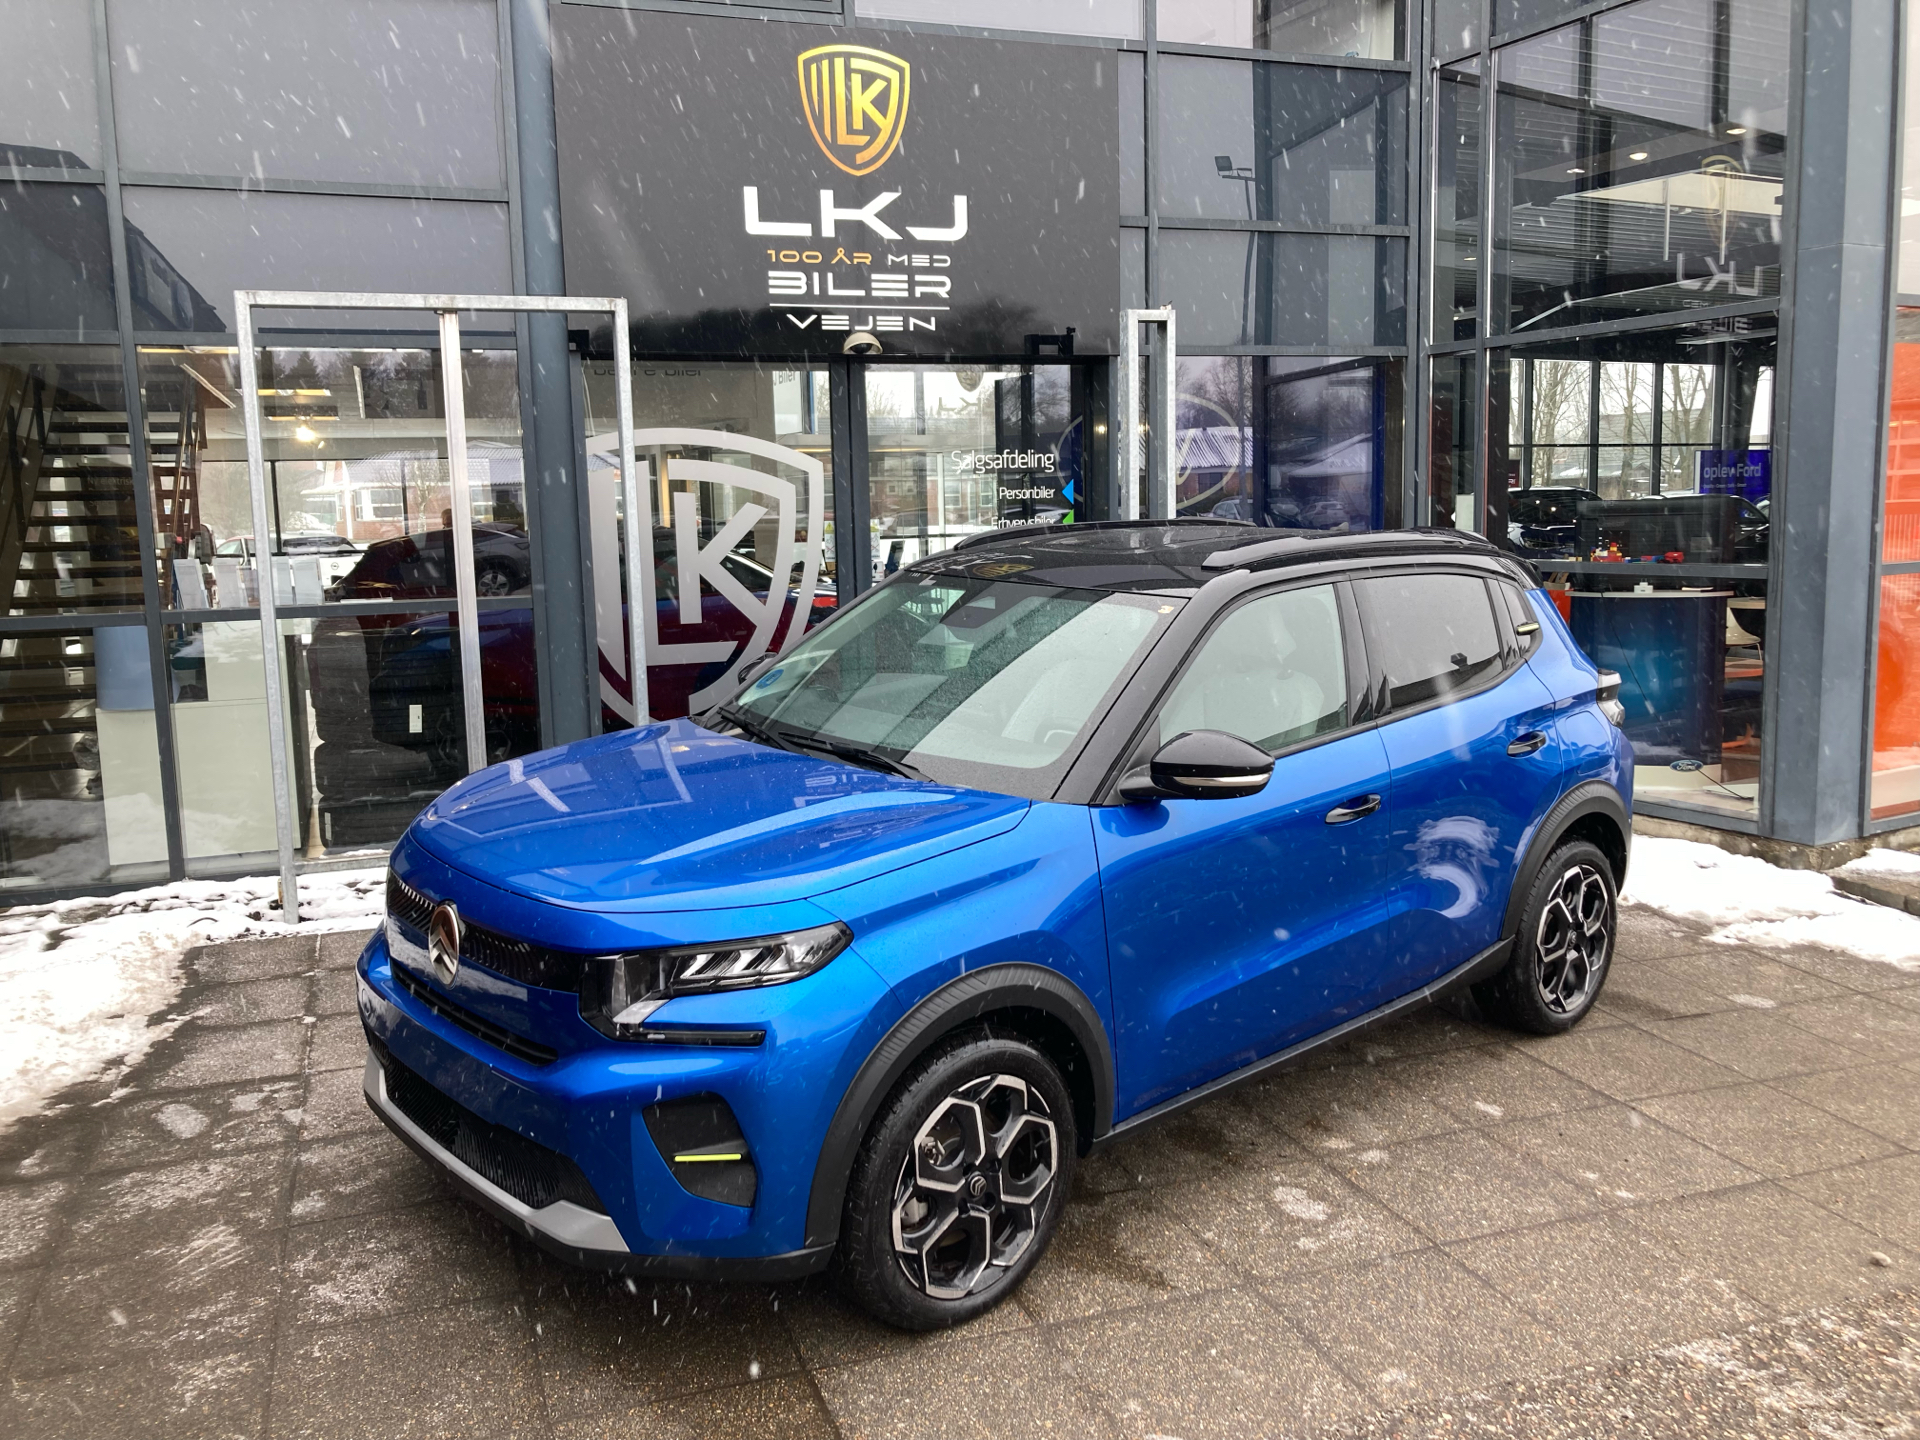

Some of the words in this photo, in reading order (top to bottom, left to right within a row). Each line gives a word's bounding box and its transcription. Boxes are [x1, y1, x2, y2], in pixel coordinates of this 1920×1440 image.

[743, 186, 968, 241] LKJ
[767, 249, 823, 264] 100
[830, 247, 873, 265] ÅR
[887, 253, 951, 267] MED
[768, 270, 952, 298] BILER
[786, 313, 936, 331] VEJEN
[1736, 462, 1762, 477] Ford
[999, 486, 1056, 500] Personbiler
